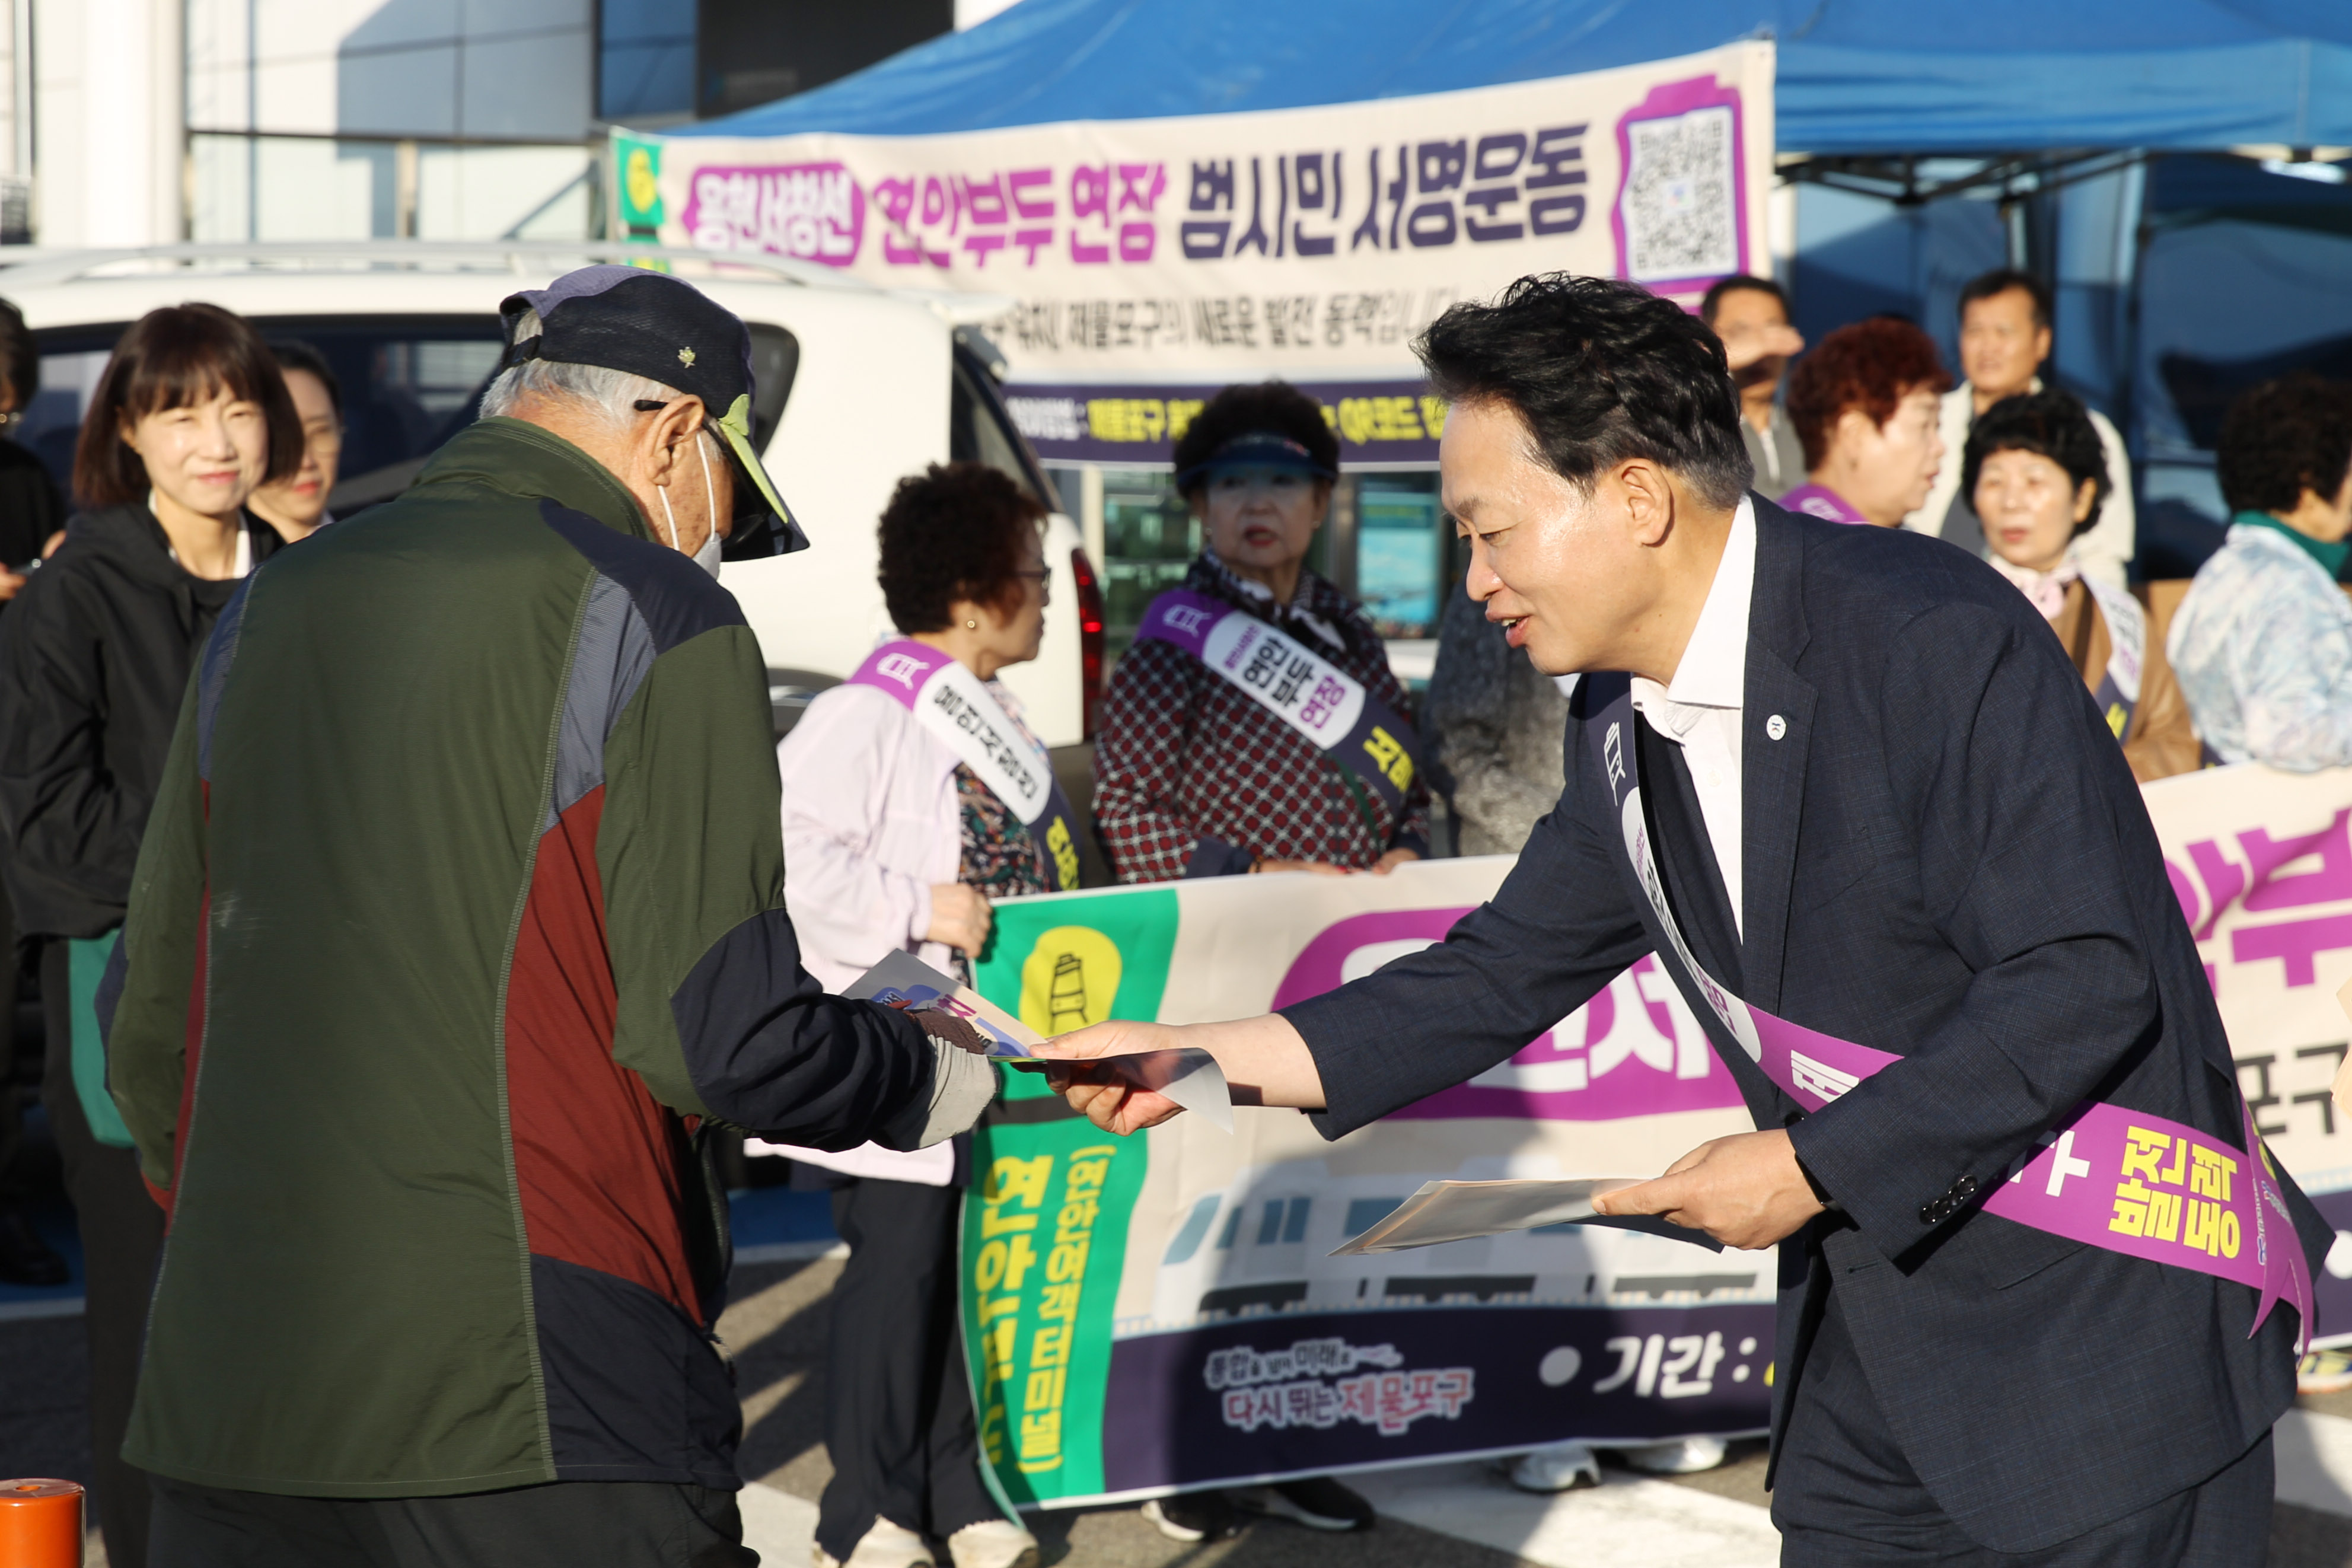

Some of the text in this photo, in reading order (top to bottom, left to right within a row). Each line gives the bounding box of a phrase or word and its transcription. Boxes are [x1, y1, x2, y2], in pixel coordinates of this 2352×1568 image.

[872, 170, 1056, 268] 연안부두
[1070, 162, 1167, 264] 연장
[1181, 151, 1341, 260] 범시민
[1353, 122, 1590, 250] 서명운동
[1244, 635, 1290, 692] 연안
[1271, 655, 1315, 707] 부두
[1299, 674, 1347, 733] 연장
[1226, 1372, 1470, 1429] 다시 뛰는 제물포구
